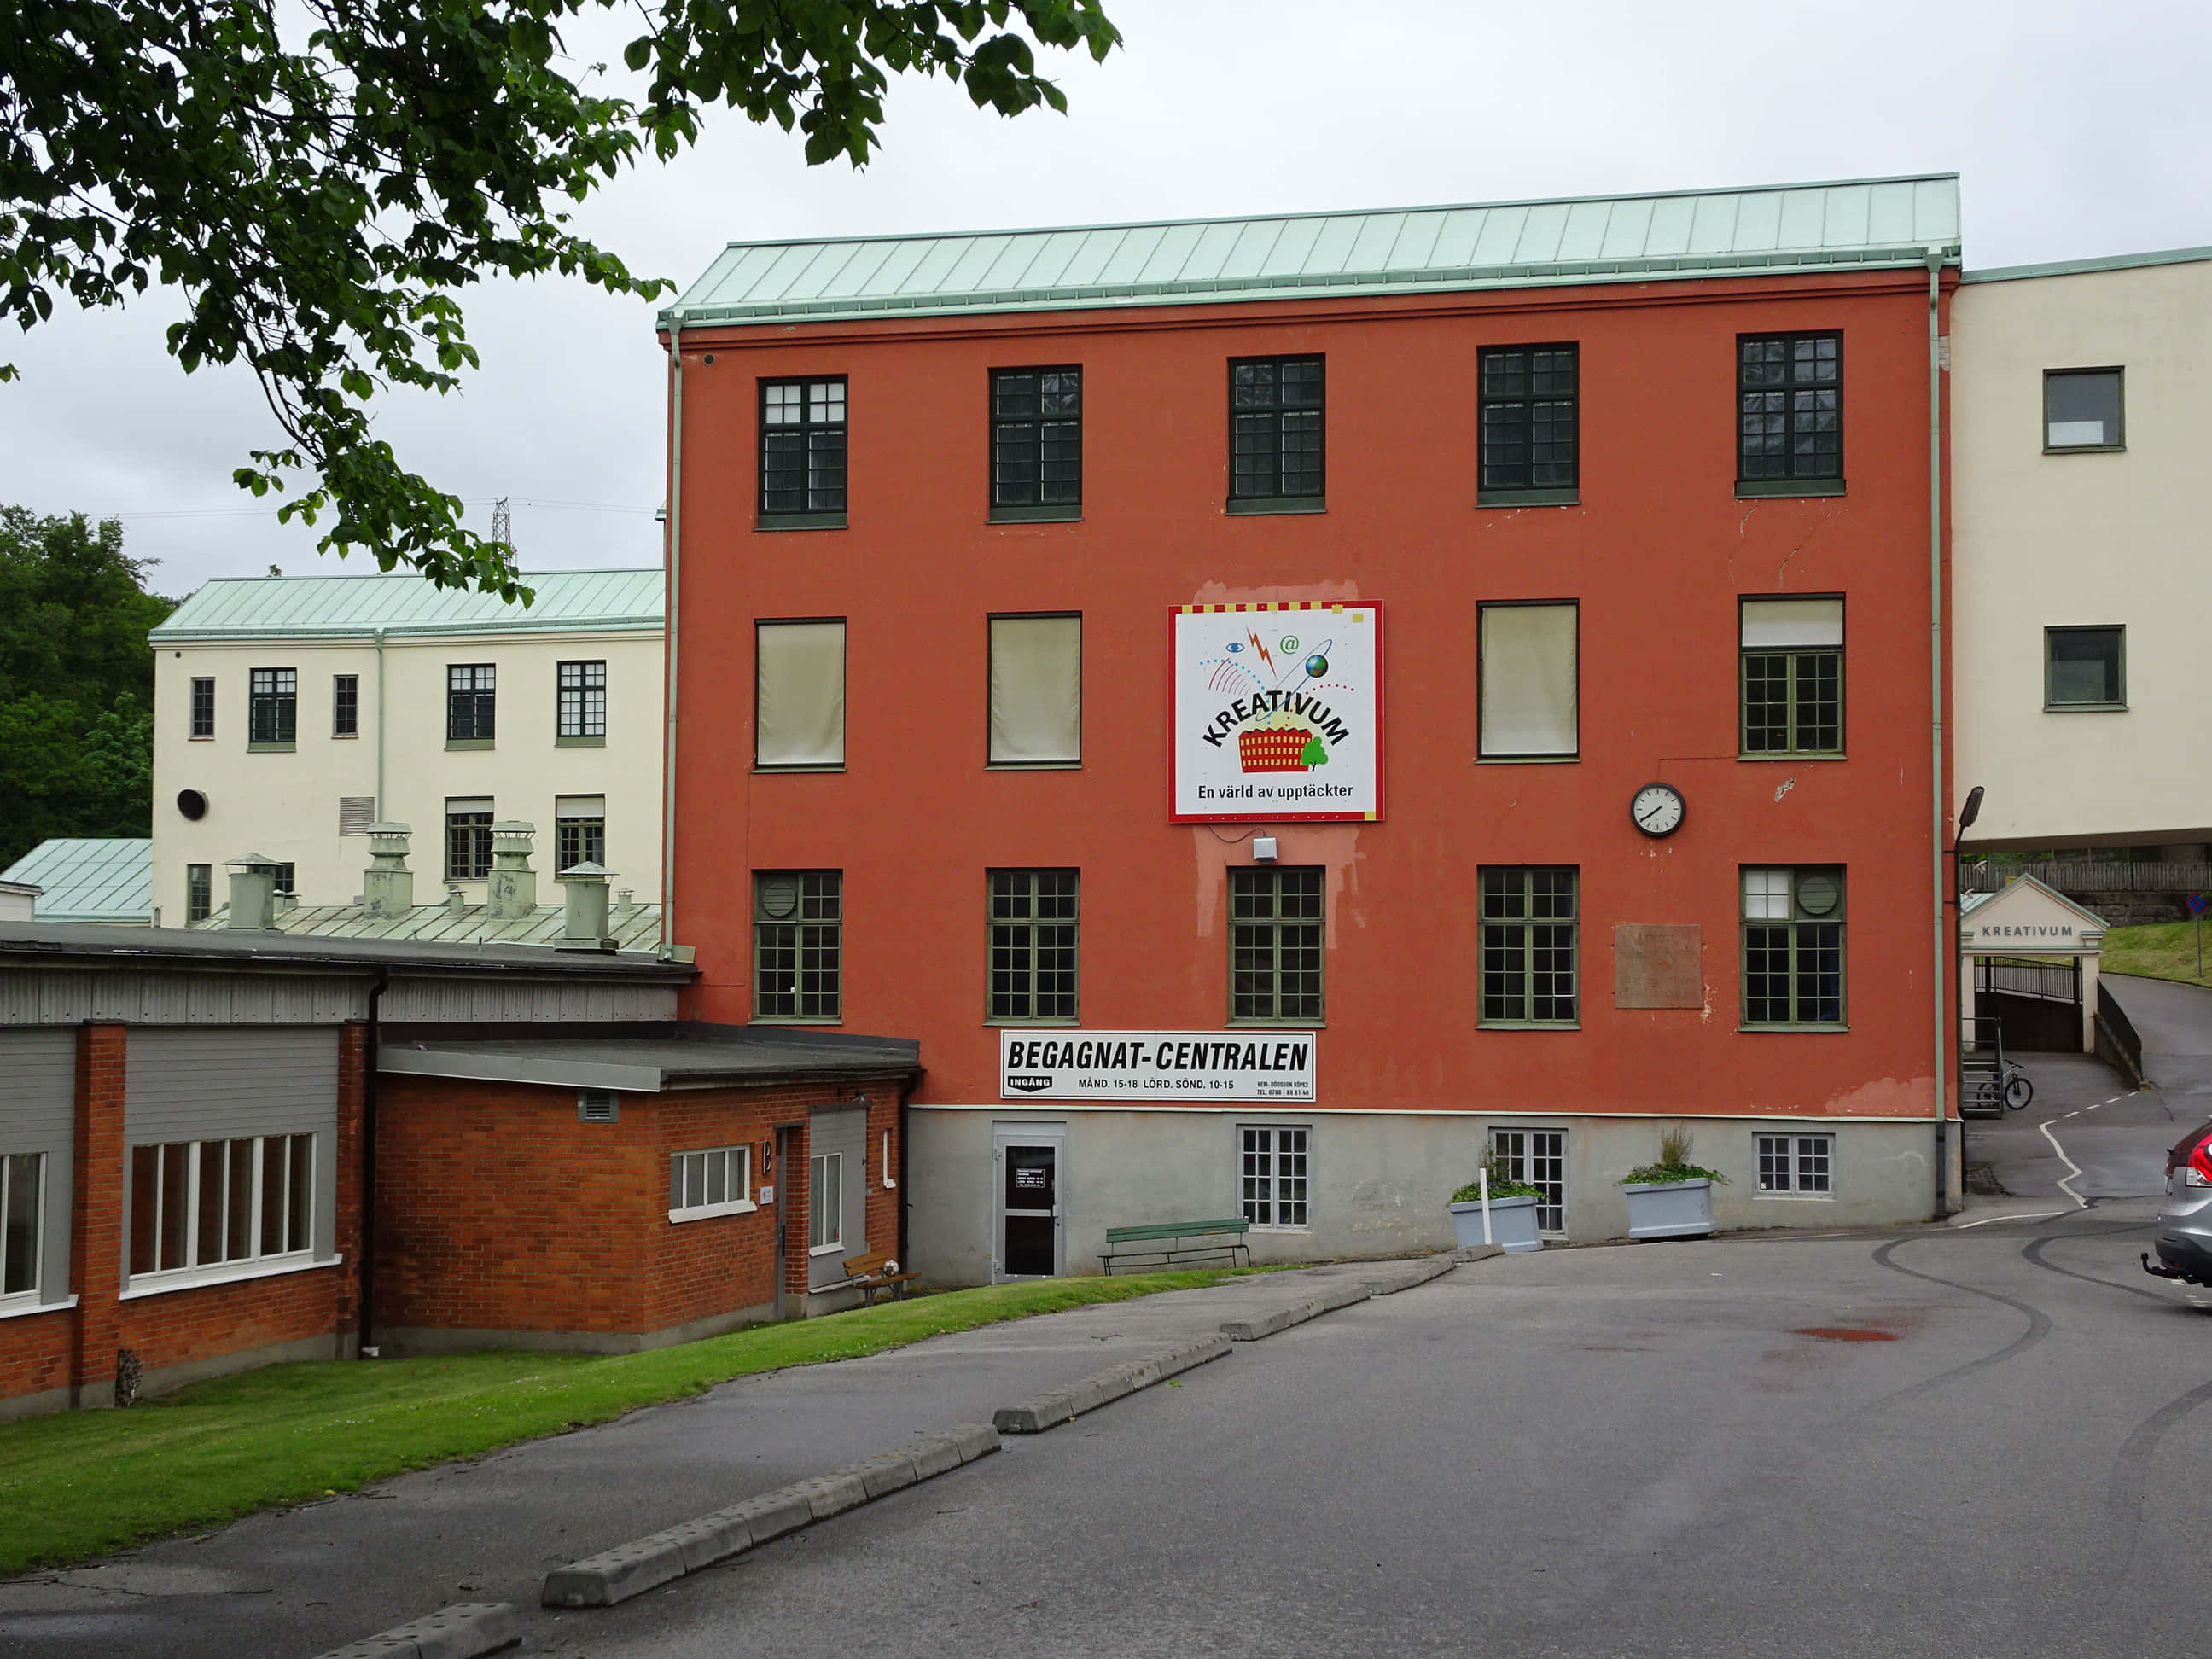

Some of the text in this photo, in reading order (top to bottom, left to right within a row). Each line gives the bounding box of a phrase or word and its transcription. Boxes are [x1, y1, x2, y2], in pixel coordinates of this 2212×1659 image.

[1202, 690, 1349, 748] KREATIVUM
[1198, 784, 1354, 800] En värld av upptäckter
[1982, 926, 2073, 936] KREATIVUM
[1010, 1077, 1051, 1086] INGÅNG
[1079, 1076, 1234, 1090] MÅND. 15-18 LÖRD. SÖND. 10-15
[762, 1140, 772, 1174] B
